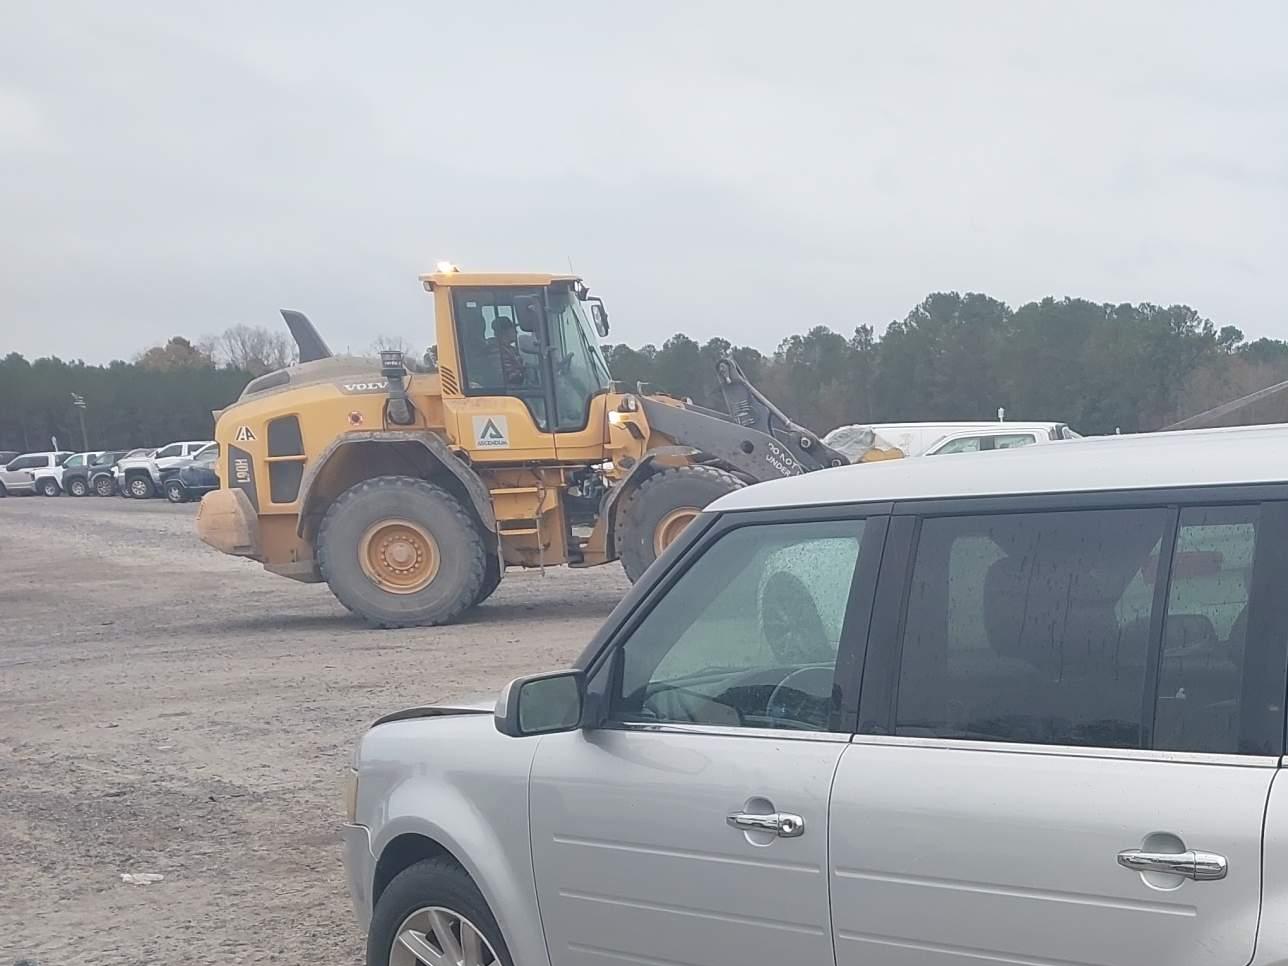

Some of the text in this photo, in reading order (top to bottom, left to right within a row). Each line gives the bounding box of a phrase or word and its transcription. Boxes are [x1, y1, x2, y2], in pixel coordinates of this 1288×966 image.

[344, 381, 389, 391] VOLV
[234, 458, 250, 482] L90H
[766, 454, 790, 476] UNDER
